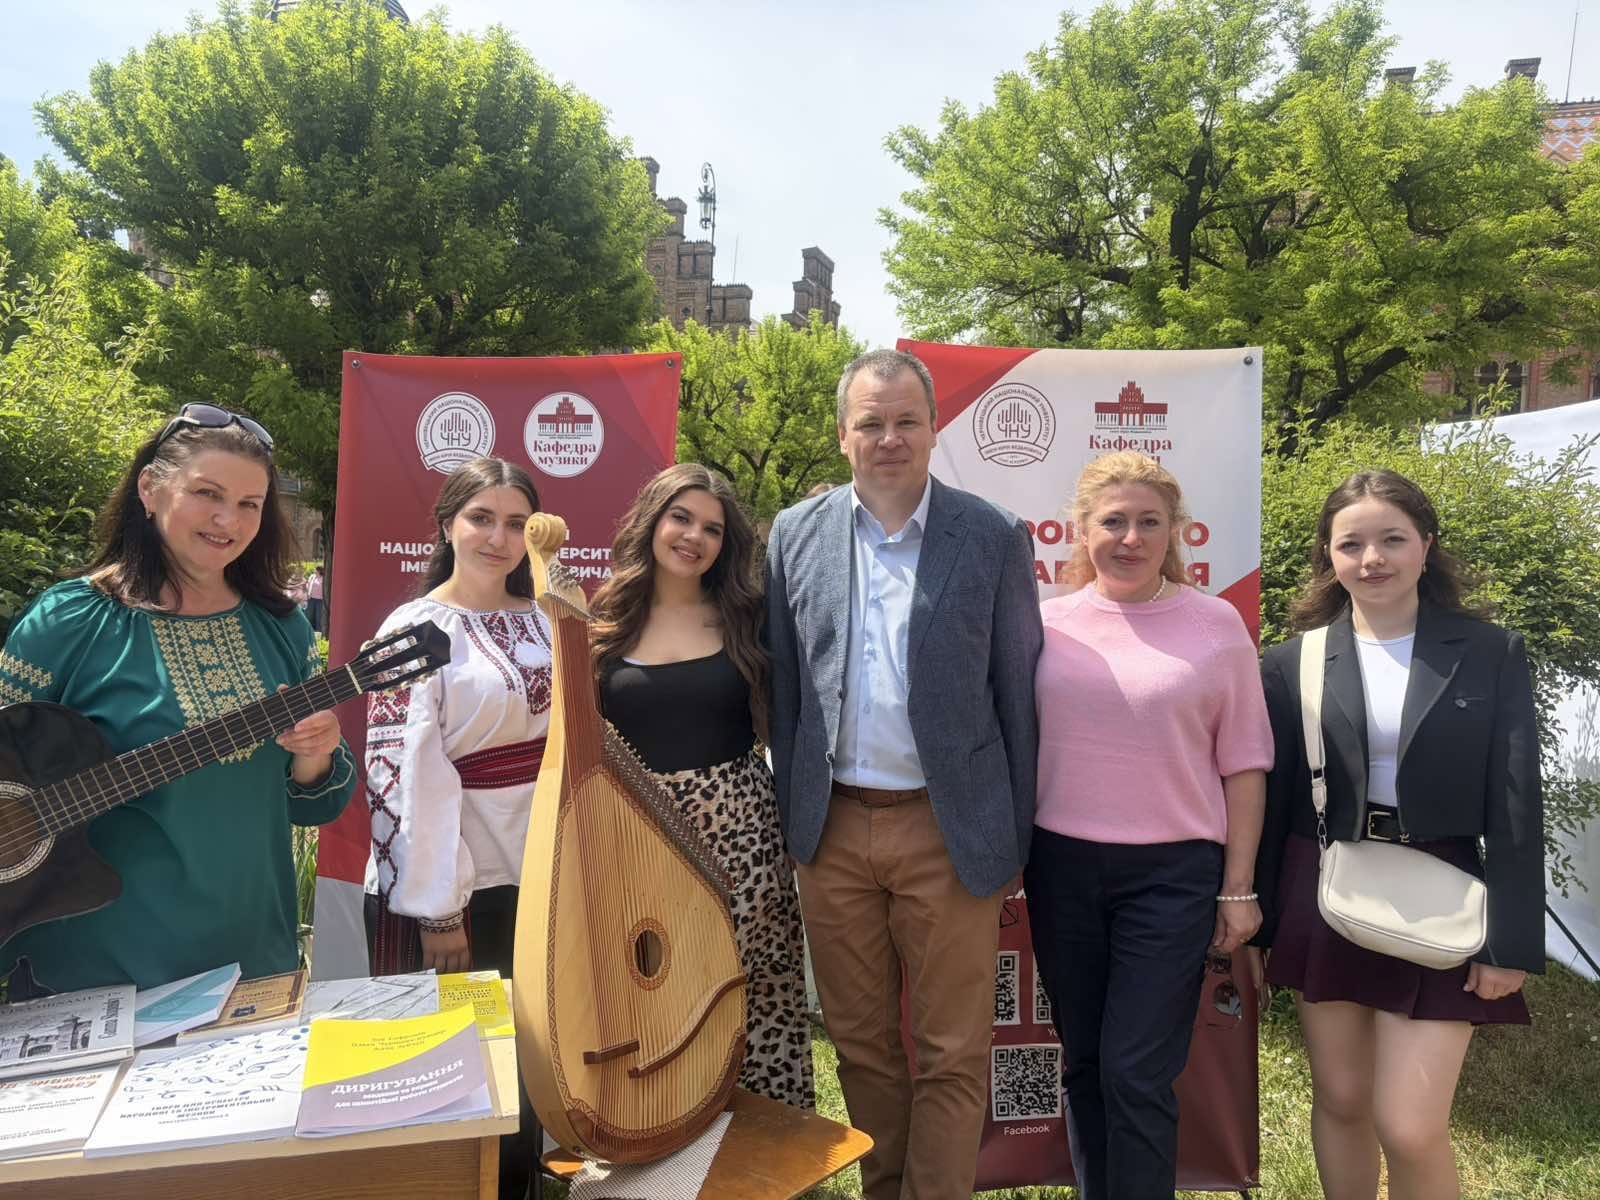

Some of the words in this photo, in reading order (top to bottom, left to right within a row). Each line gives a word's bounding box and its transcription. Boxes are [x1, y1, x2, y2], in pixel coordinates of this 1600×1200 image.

[534, 440, 597, 455] Кафедра
[1089, 434, 1172, 453] Кафедра
[331, 1059, 464, 1095] ДИРИГУВАННЯ
[1003, 1123, 1051, 1136] Facebook
